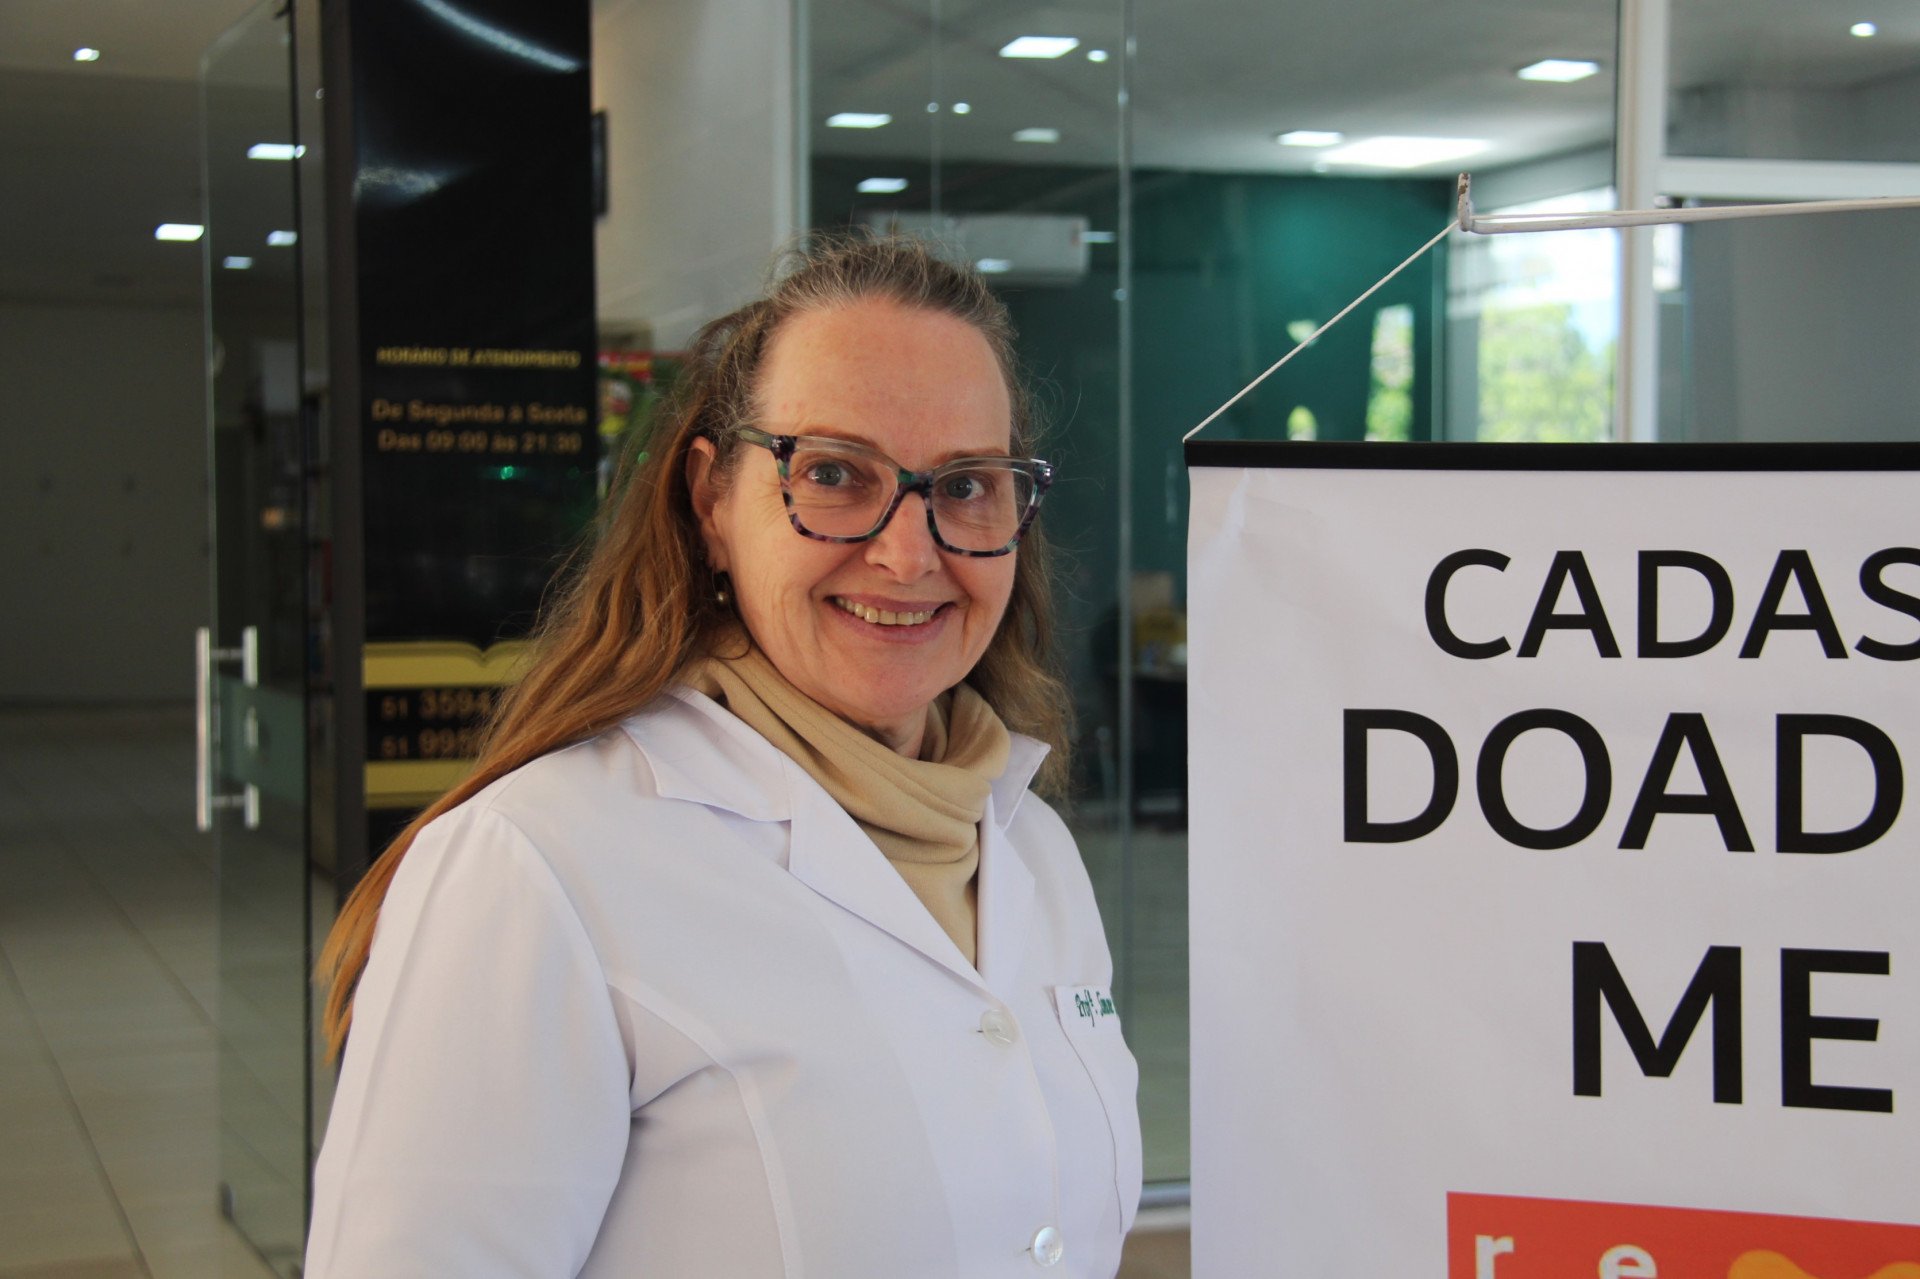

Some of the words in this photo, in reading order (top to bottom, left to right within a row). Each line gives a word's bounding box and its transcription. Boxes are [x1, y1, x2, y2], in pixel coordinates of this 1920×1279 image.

[450, 349, 471, 367] DE
[372, 400, 403, 421] De
[408, 400, 504, 425] Segunda
[527, 402, 588, 425] Sexta
[378, 430, 422, 451] Das
[1424, 546, 1920, 662] CADAS
[1343, 708, 1904, 855] DOAD
[1572, 941, 1893, 1114] ME
